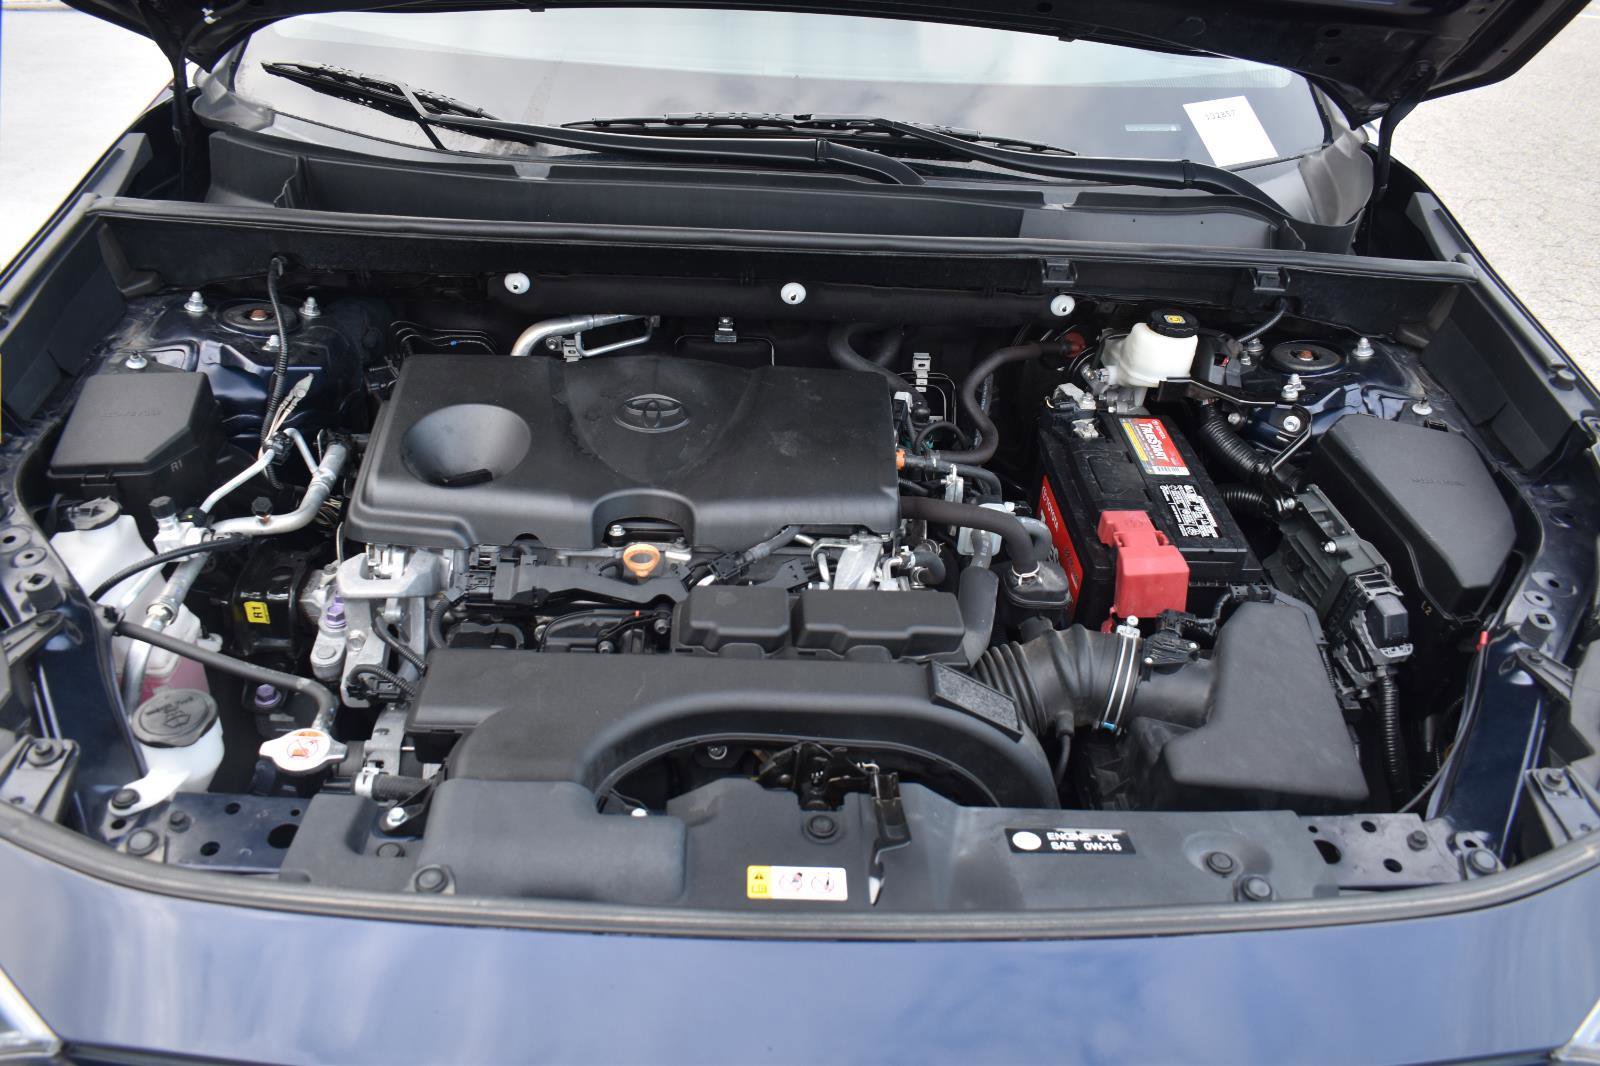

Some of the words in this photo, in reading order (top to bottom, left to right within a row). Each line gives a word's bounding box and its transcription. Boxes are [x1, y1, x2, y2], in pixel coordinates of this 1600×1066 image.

[1046, 832, 1091, 842] ENGINE
[1098, 833, 1118, 842] OIL
[1050, 842, 1076, 851] SAE
[1083, 842, 1122, 852] 0W-16
